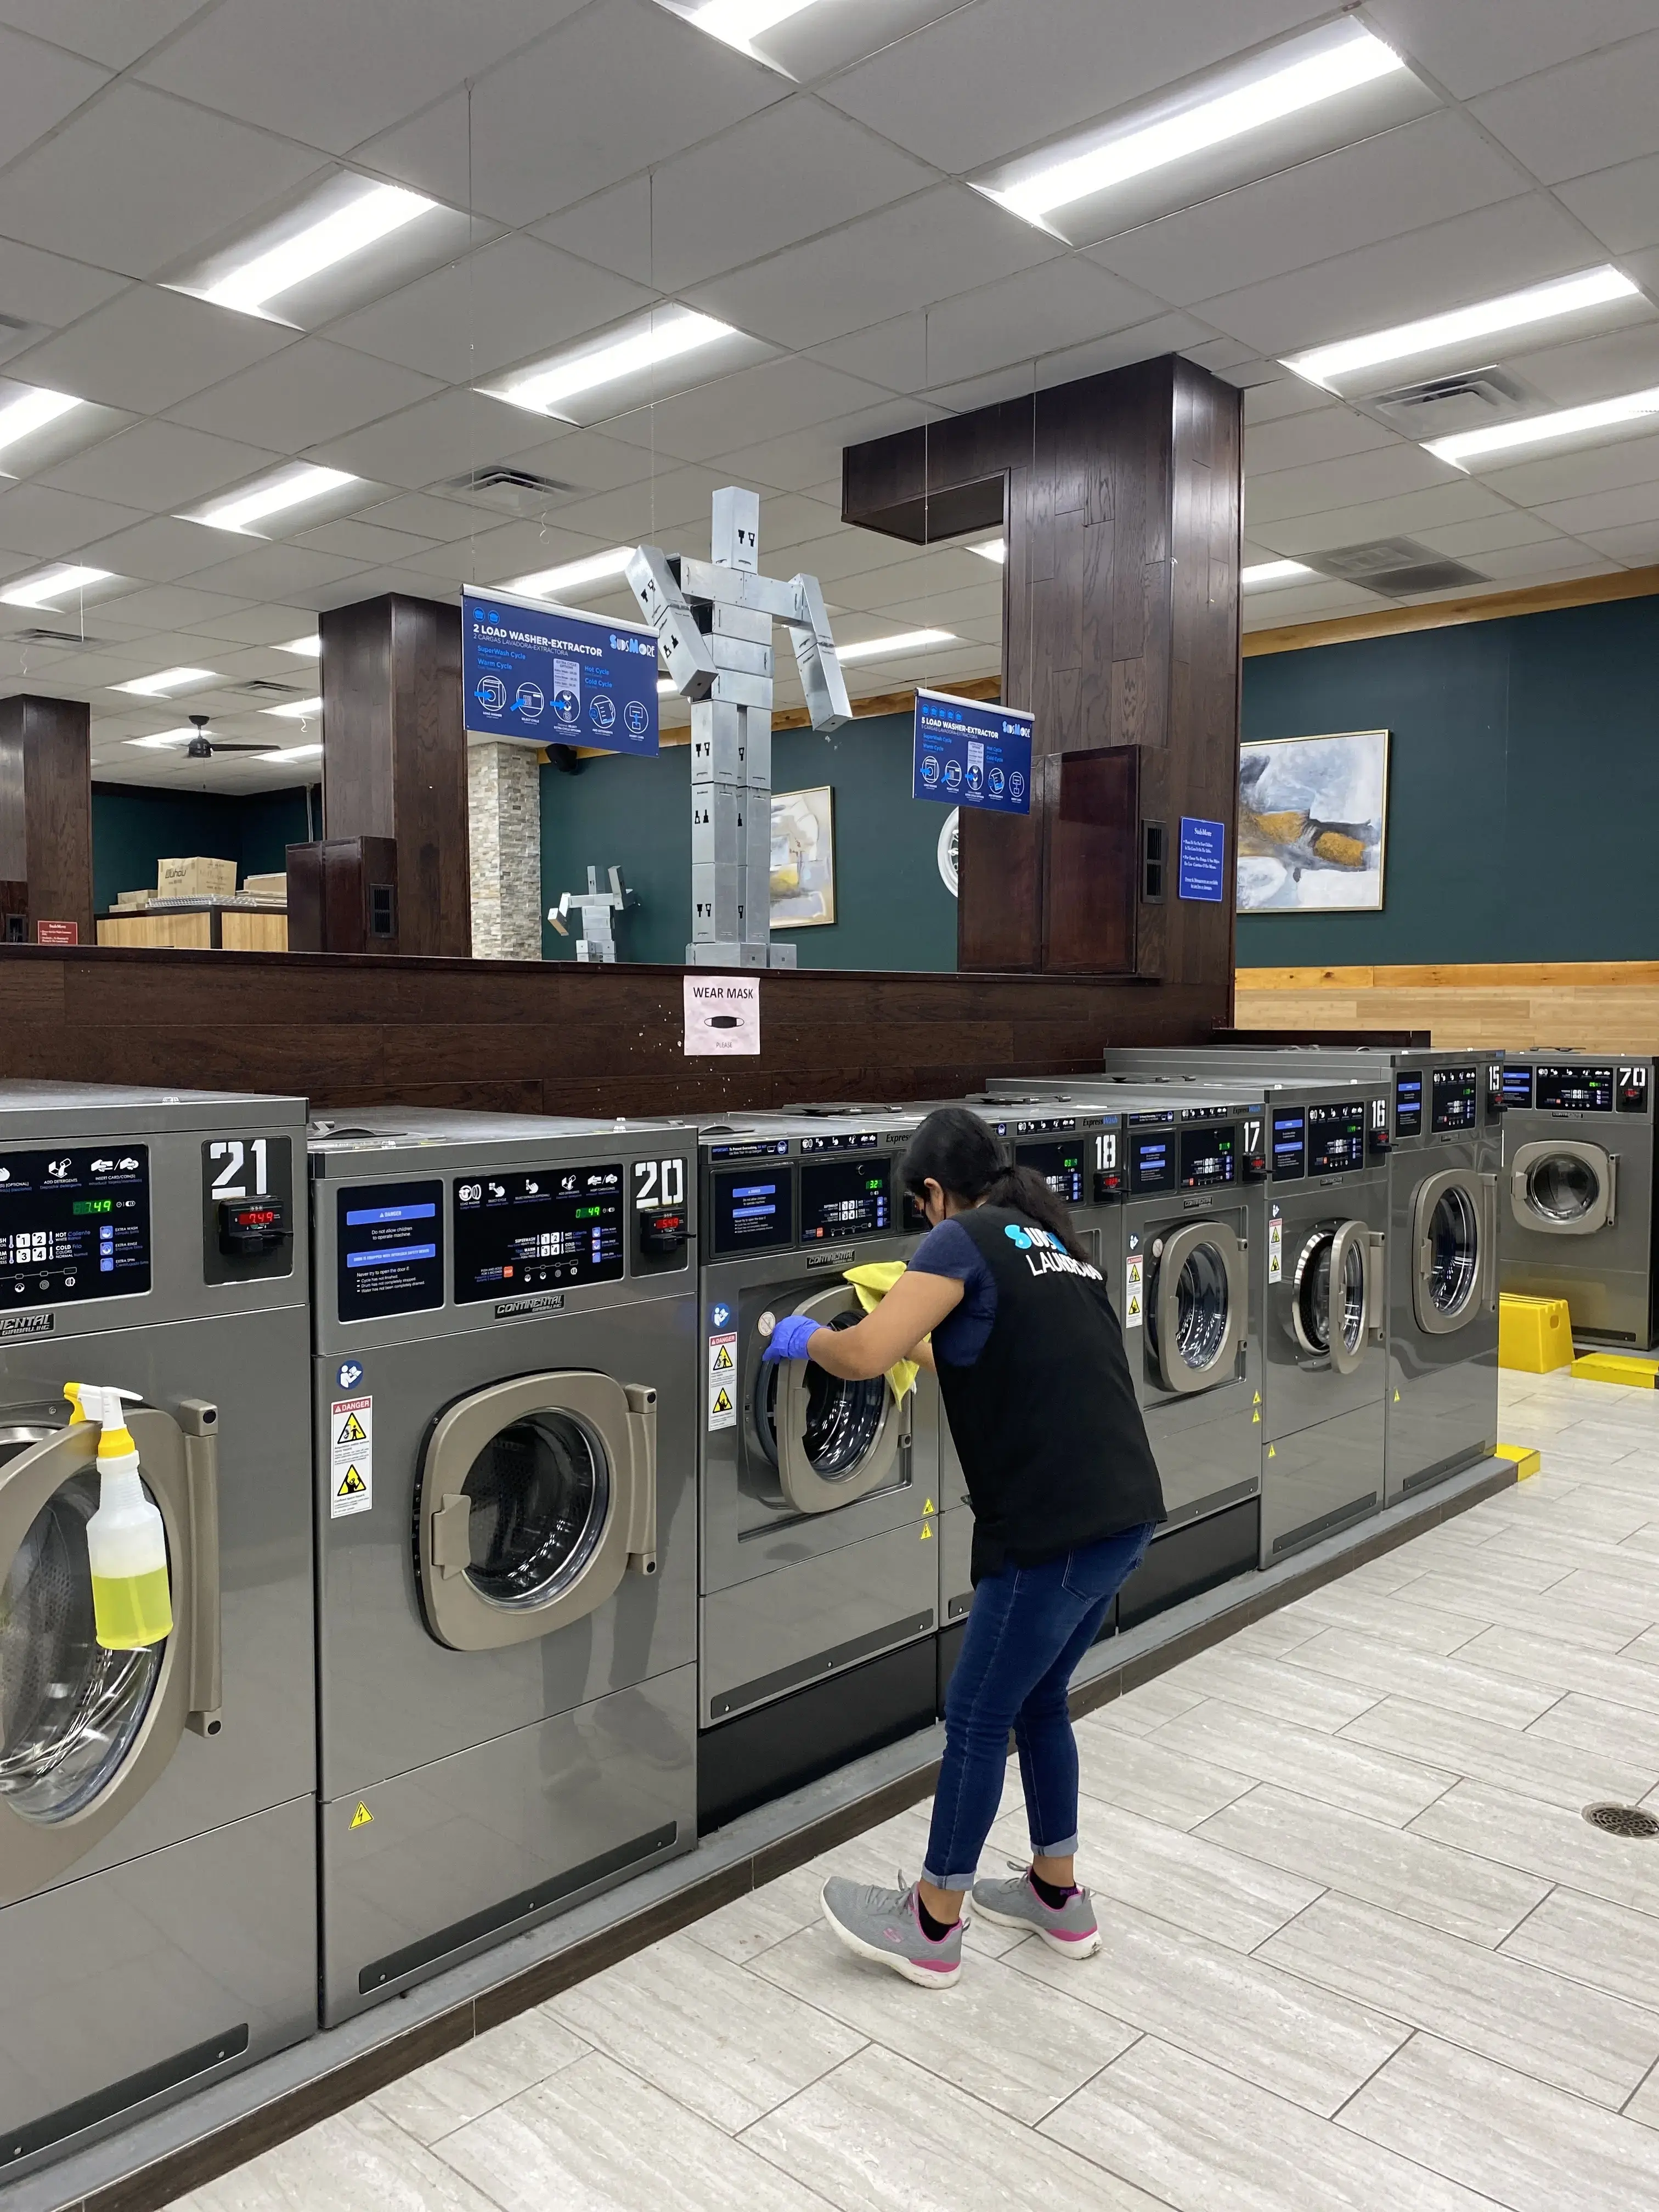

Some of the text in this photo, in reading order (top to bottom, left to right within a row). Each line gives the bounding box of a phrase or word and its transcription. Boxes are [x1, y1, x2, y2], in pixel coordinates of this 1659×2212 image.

[473, 624, 479, 633] 2
[481, 625, 507, 637] LOAD
[509, 630, 602, 657] WASHER-EXTRACTOR
[478, 634, 501, 644] CARGAS
[502, 639, 568, 656] LAVADORA-EXTRACTORA
[477, 645, 509, 657] SuperWash
[510, 652, 526, 660] Cycle
[477, 658, 495, 667] Warm
[595, 667, 610, 675] Cycle
[926, 718, 941, 727] LOAD
[943, 721, 998, 739] WASHER-EXTRACTOR
[693, 987, 753, 999] WEAR MASK
[1489, 1066, 1500, 1091] 15
[1619, 1067, 1646, 1086] 70
[1082, 1115, 1118, 1128] ExpressWash
[1372, 1100, 1385, 1128] 16
[1244, 1121, 1260, 1153] 17
[1096, 1135, 1116, 1170] 18
[210, 1139, 267, 1200] 21
[635, 1159, 683, 1209] 20
[37, 1235, 43, 1244] 2
[21, 1252, 27, 1261] 3
[37, 1250, 43, 1259] 4
[496, 1295, 562, 1314] CONTINENTAL
[716, 1335, 735, 1344] DANGER
[342, 1400, 370, 1412] DANGER
